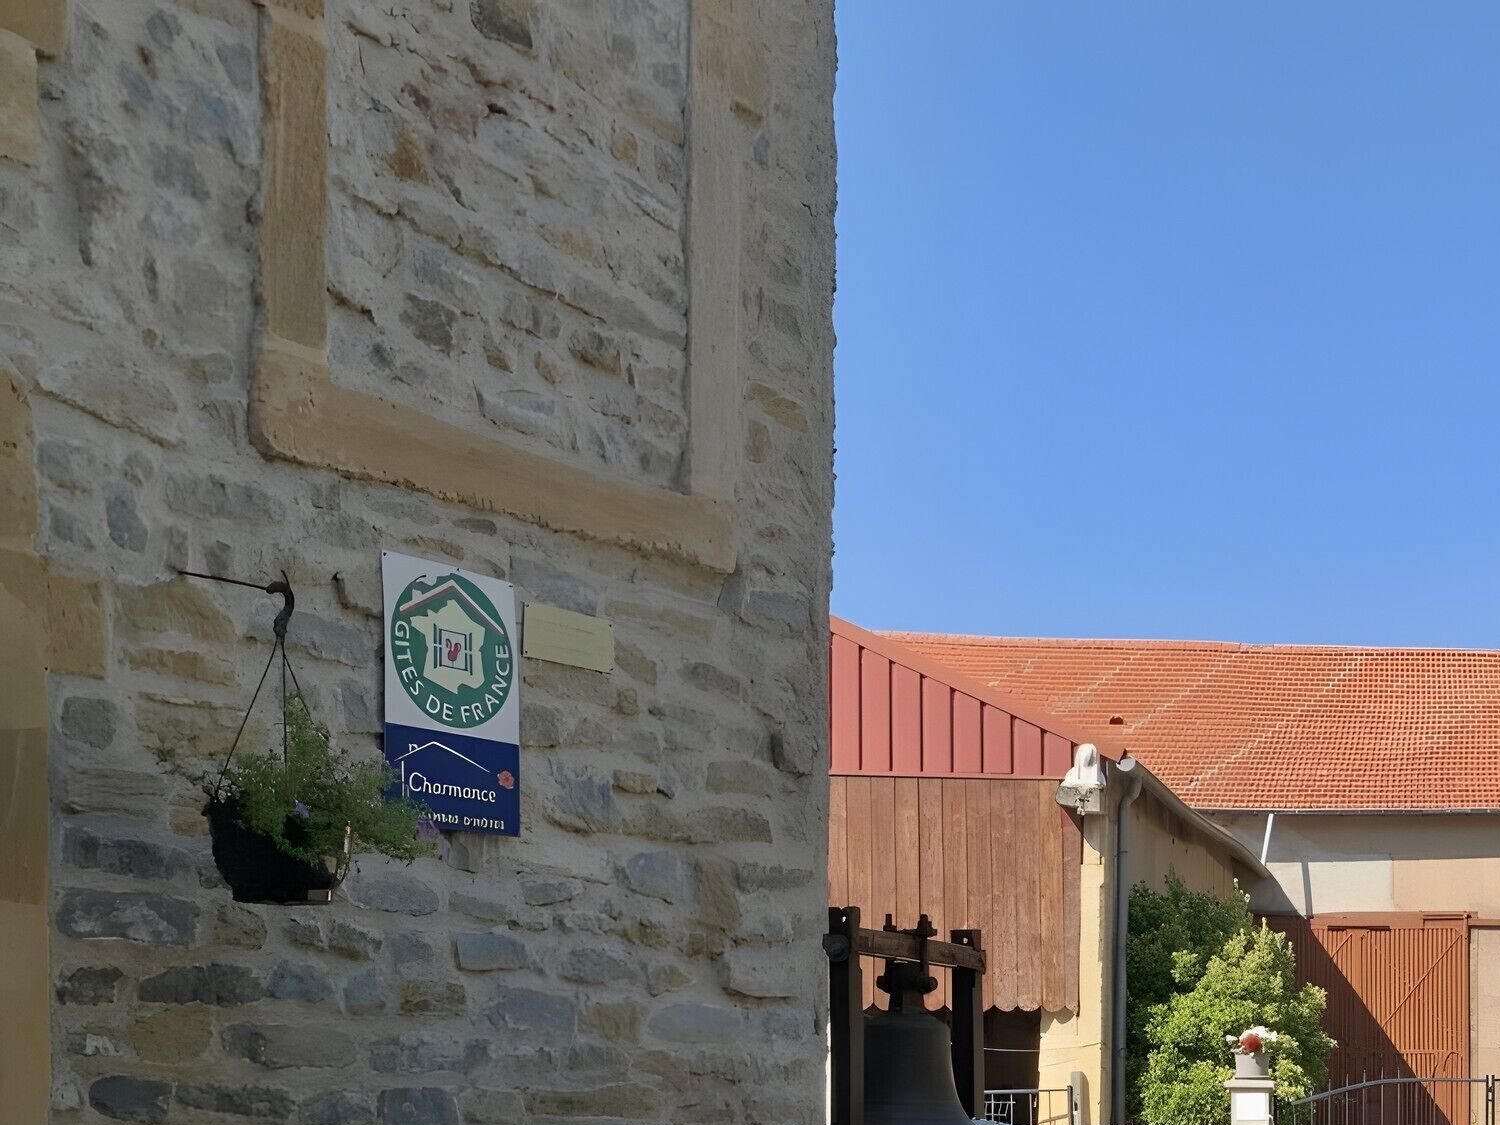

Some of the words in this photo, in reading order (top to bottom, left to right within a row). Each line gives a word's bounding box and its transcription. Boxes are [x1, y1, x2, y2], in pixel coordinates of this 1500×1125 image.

[394, 620, 425, 696] GITES
[426, 694, 453, 722] DE
[460, 645, 510, 723] FRANCE
